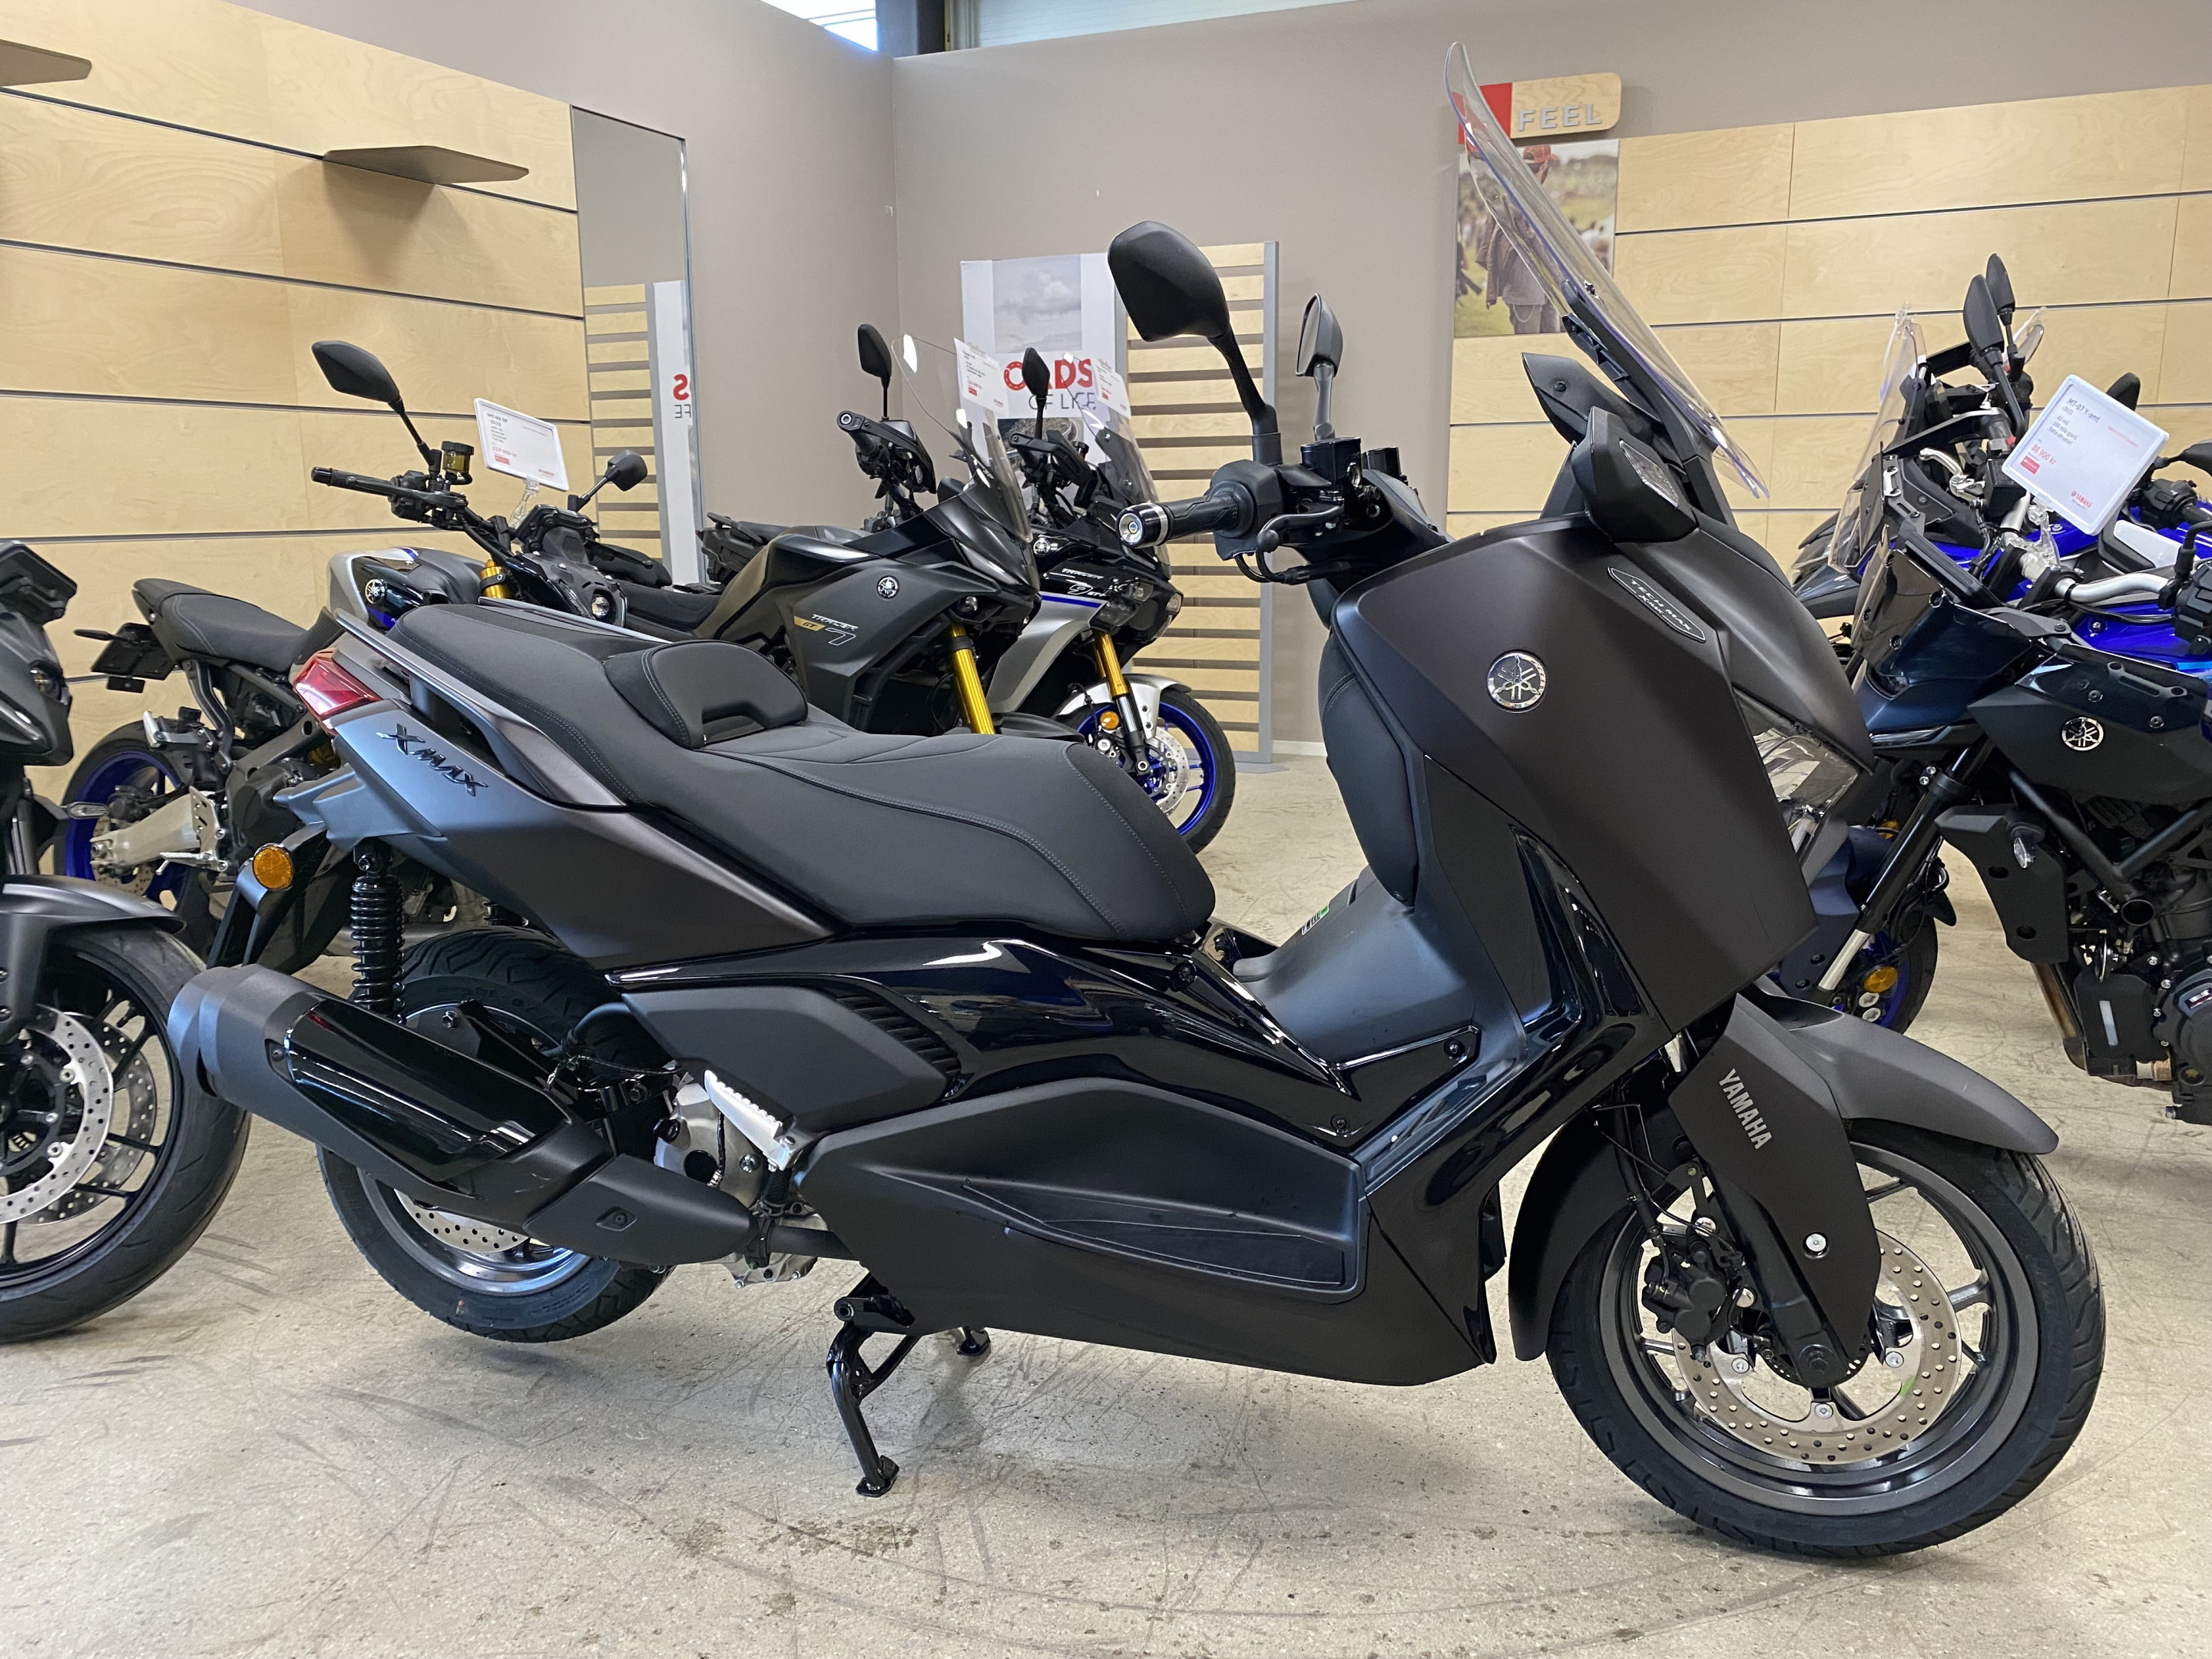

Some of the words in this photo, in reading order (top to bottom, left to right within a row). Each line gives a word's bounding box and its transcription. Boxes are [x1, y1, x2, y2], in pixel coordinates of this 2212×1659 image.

[1518, 103, 1602, 131] FEEL
[1004, 359, 1093, 392] ODS
[2067, 398, 2085, 411] MT-07
[1631, 579, 1664, 608] TECH
[1665, 609, 1692, 631] MAX
[825, 627, 856, 646] 7
[375, 723, 489, 797] XMAX
[1719, 1068, 1772, 1150] YAMAHA
